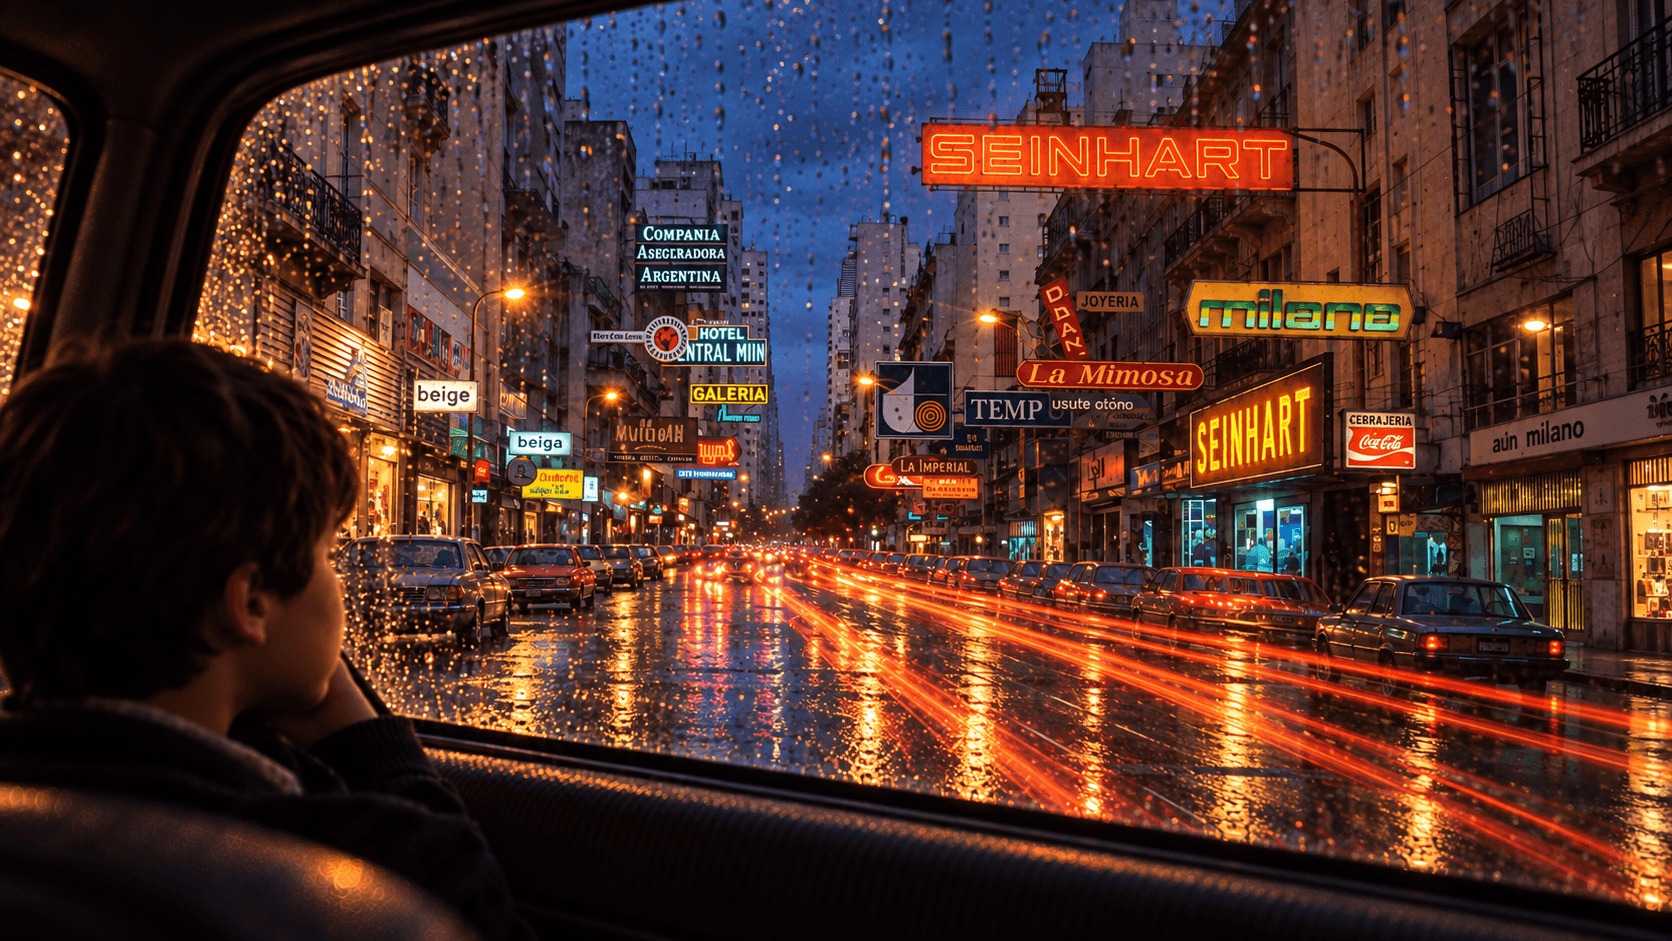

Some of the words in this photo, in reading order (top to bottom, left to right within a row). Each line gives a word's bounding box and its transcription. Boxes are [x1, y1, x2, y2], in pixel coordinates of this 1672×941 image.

[930, 133, 1288, 180] SEINHART
[643, 225, 721, 241] COMPANIA
[640, 266, 722, 283] ARGENTINA
[1081, 295, 1140, 308] JOYERIA
[1199, 288, 1402, 332] milana
[699, 327, 745, 340] HOTEL
[1028, 363, 1066, 385] La
[1077, 363, 1193, 386] Mimosa
[417, 385, 470, 406] beige
[692, 387, 766, 402] GALERIA
[1052, 398, 1091, 411] usute
[1196, 387, 1311, 475] SEINHART
[1526, 419, 1585, 447] milano
[518, 435, 563, 451] beiga
[900, 459, 915, 473] LA
[919, 459, 971, 473] IMPERIAL
